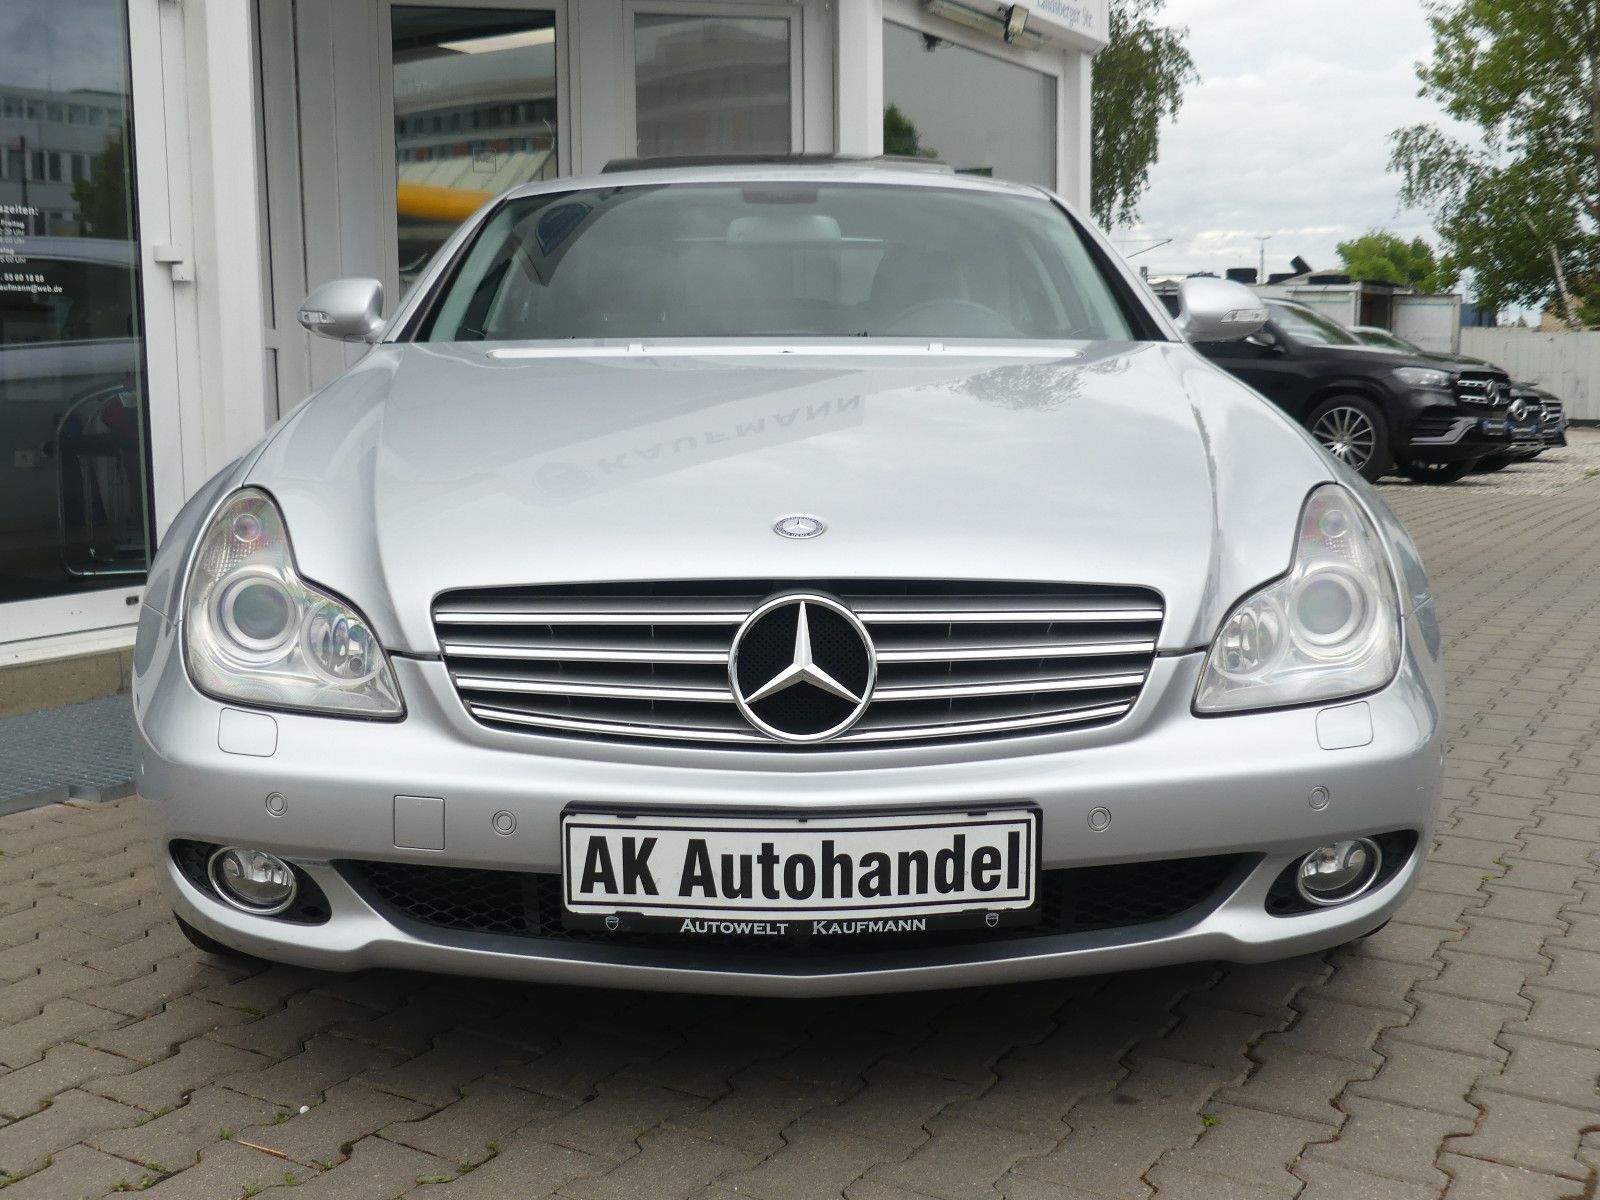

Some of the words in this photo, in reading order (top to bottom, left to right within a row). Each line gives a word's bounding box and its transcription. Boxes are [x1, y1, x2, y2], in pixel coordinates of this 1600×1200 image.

[580, 835, 659, 896] AK
[679, 831, 1020, 900] Autohandel
[680, 918, 788, 935] AUTOWELT
[813, 918, 926, 935] KAUFMANN
